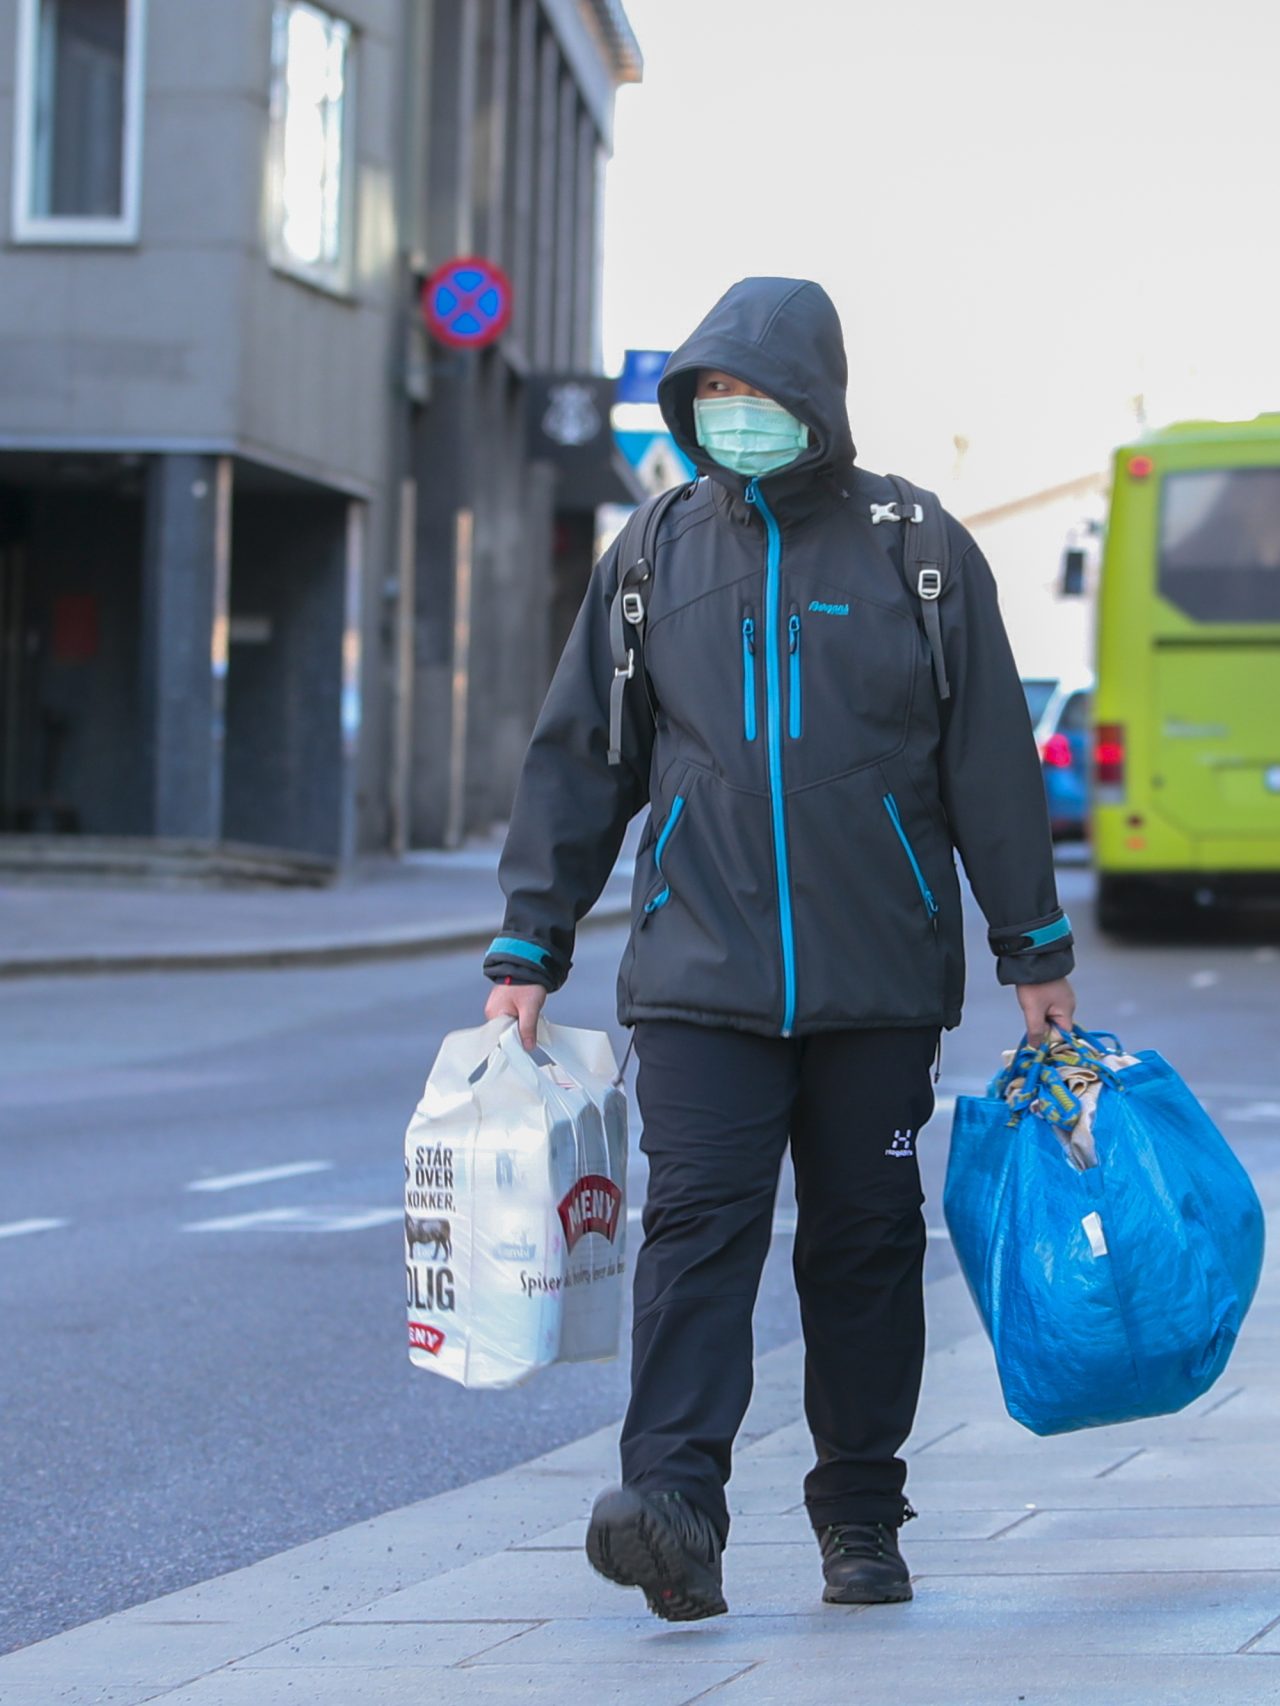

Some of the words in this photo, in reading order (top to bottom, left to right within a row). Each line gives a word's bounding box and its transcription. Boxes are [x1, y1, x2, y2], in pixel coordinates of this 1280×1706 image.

[416, 1141, 453, 1168] STÅR
[415, 1166, 453, 1188] OVER
[568, 1189, 616, 1235] MENY
[520, 1270, 561, 1298] Spiser
